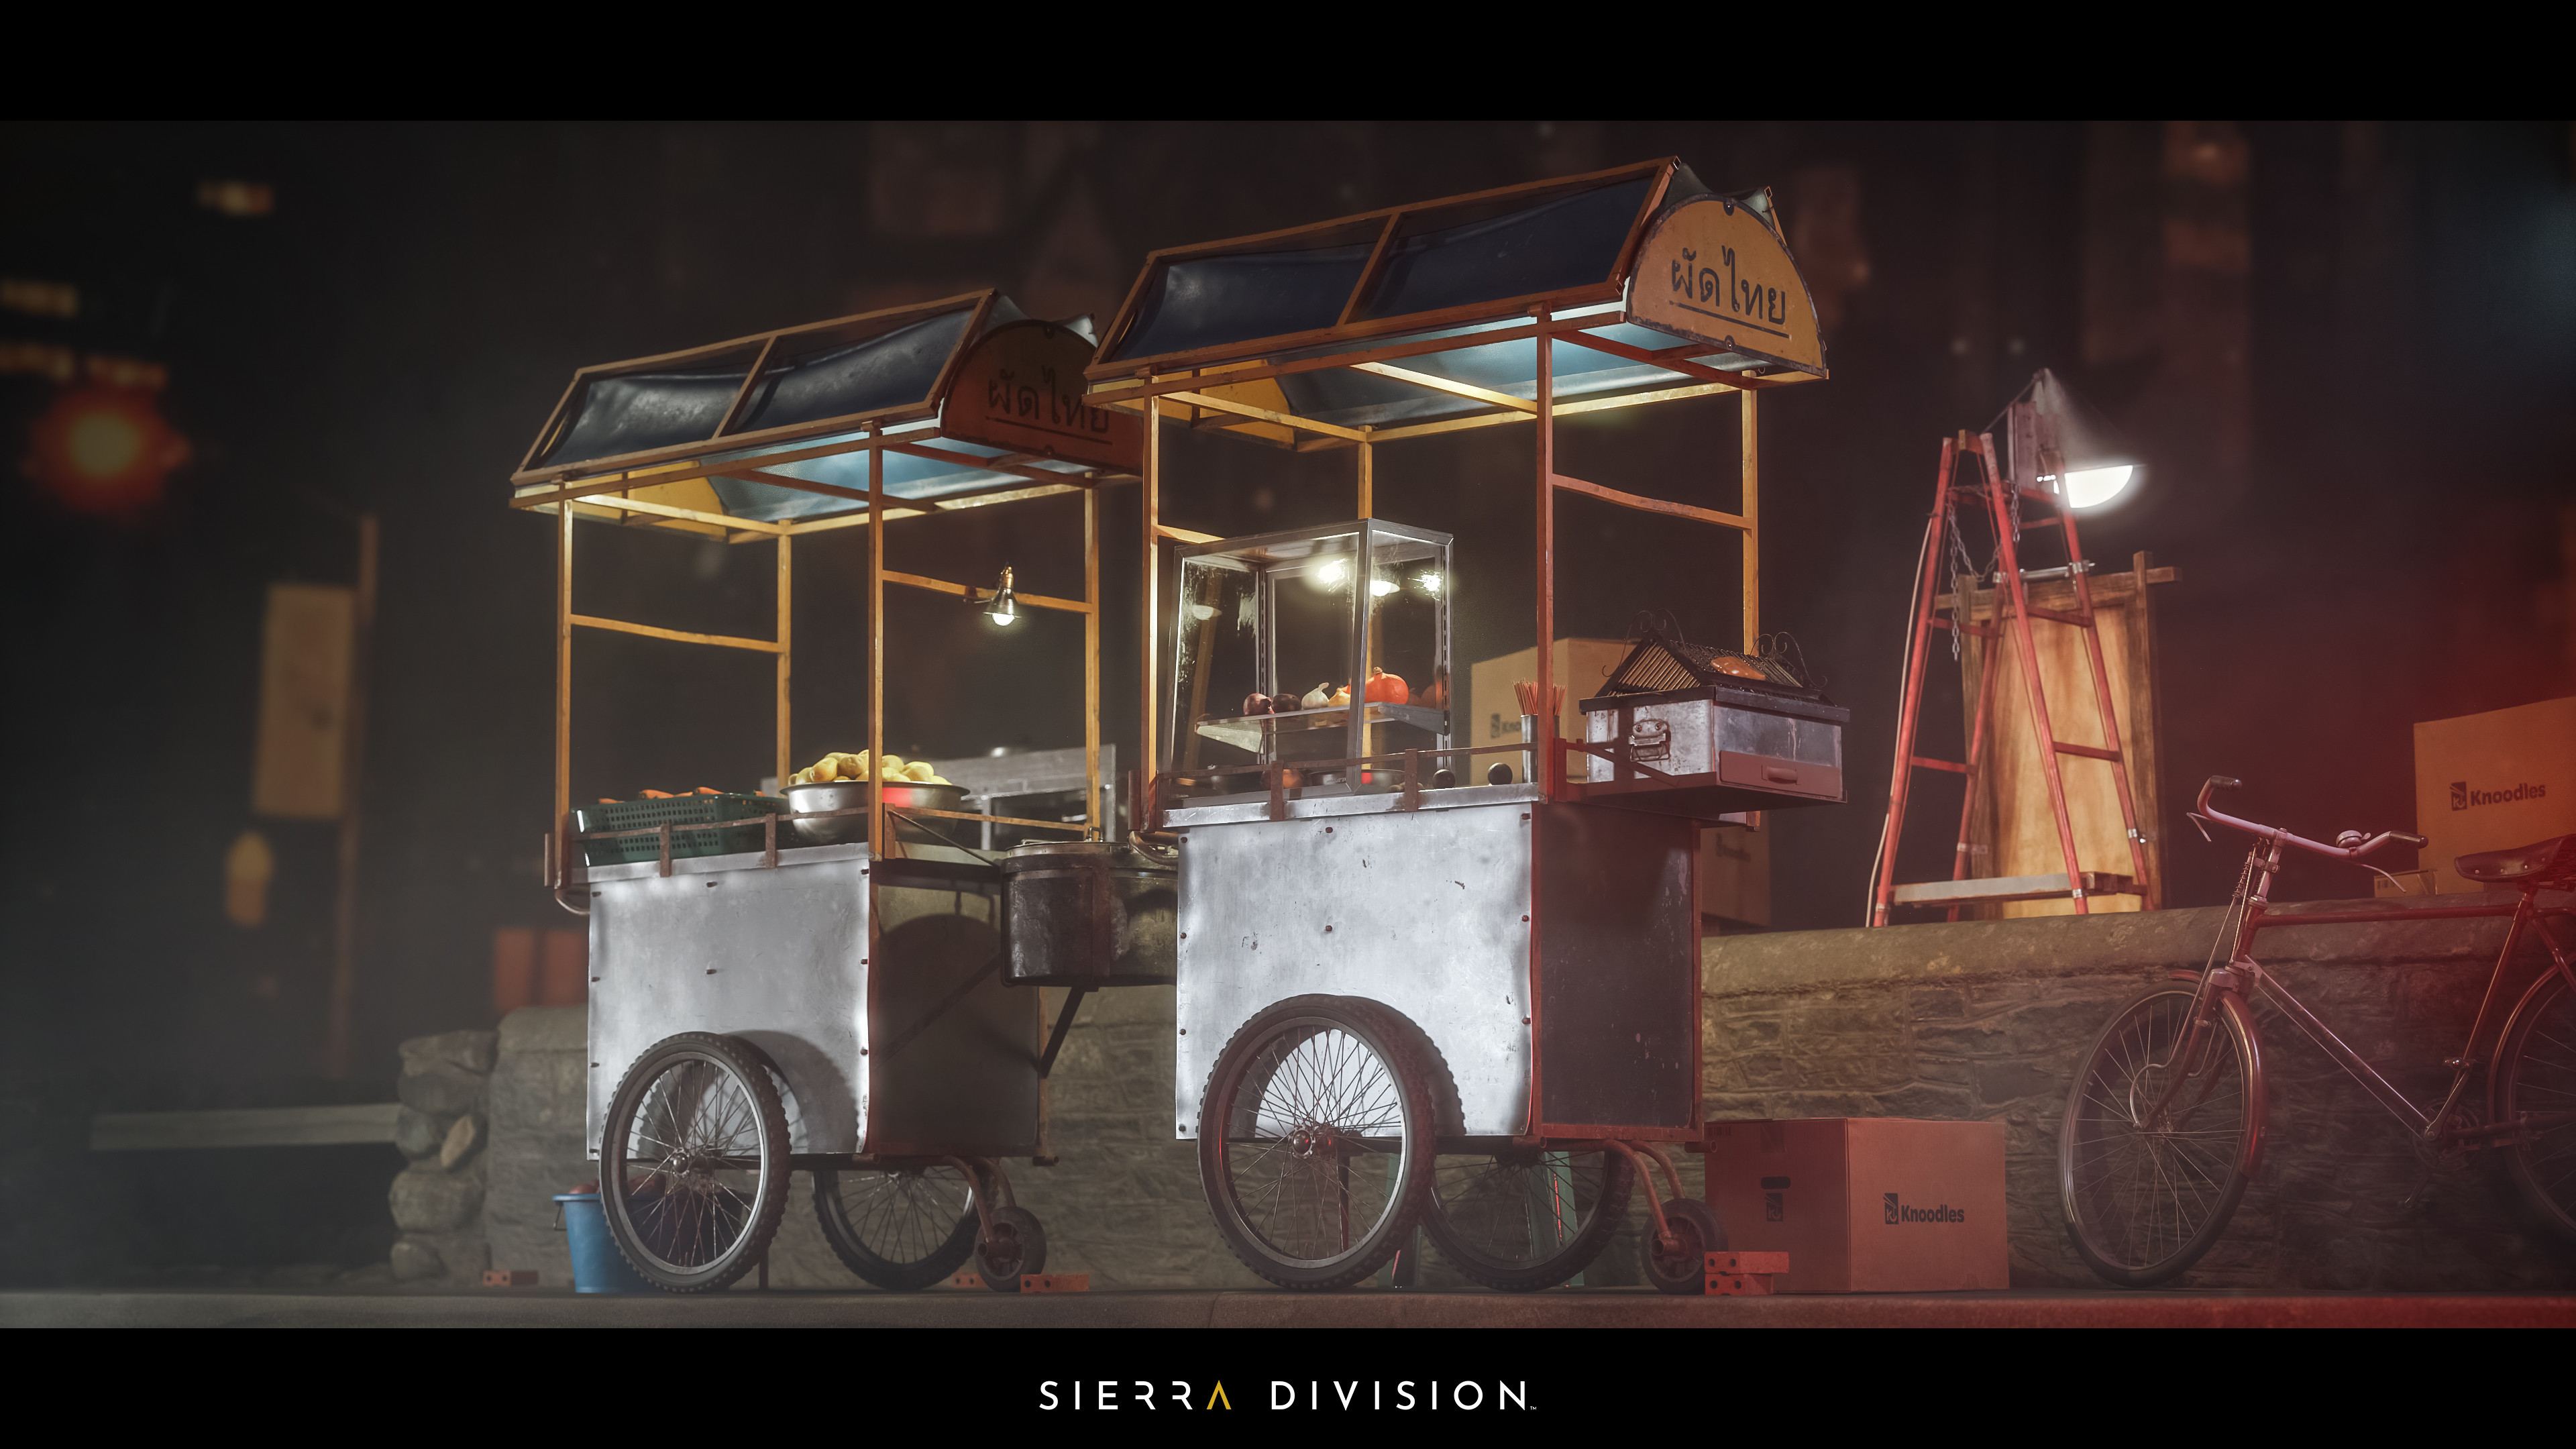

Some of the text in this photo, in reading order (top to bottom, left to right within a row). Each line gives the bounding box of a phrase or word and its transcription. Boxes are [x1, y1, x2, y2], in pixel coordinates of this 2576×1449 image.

[1671, 245, 1786, 325] ผัดไทย
[988, 365, 1109, 434] ผัดไทย
[2470, 782, 2546, 807] Knoodles
[1900, 1204, 1965, 1224] Knoodles
